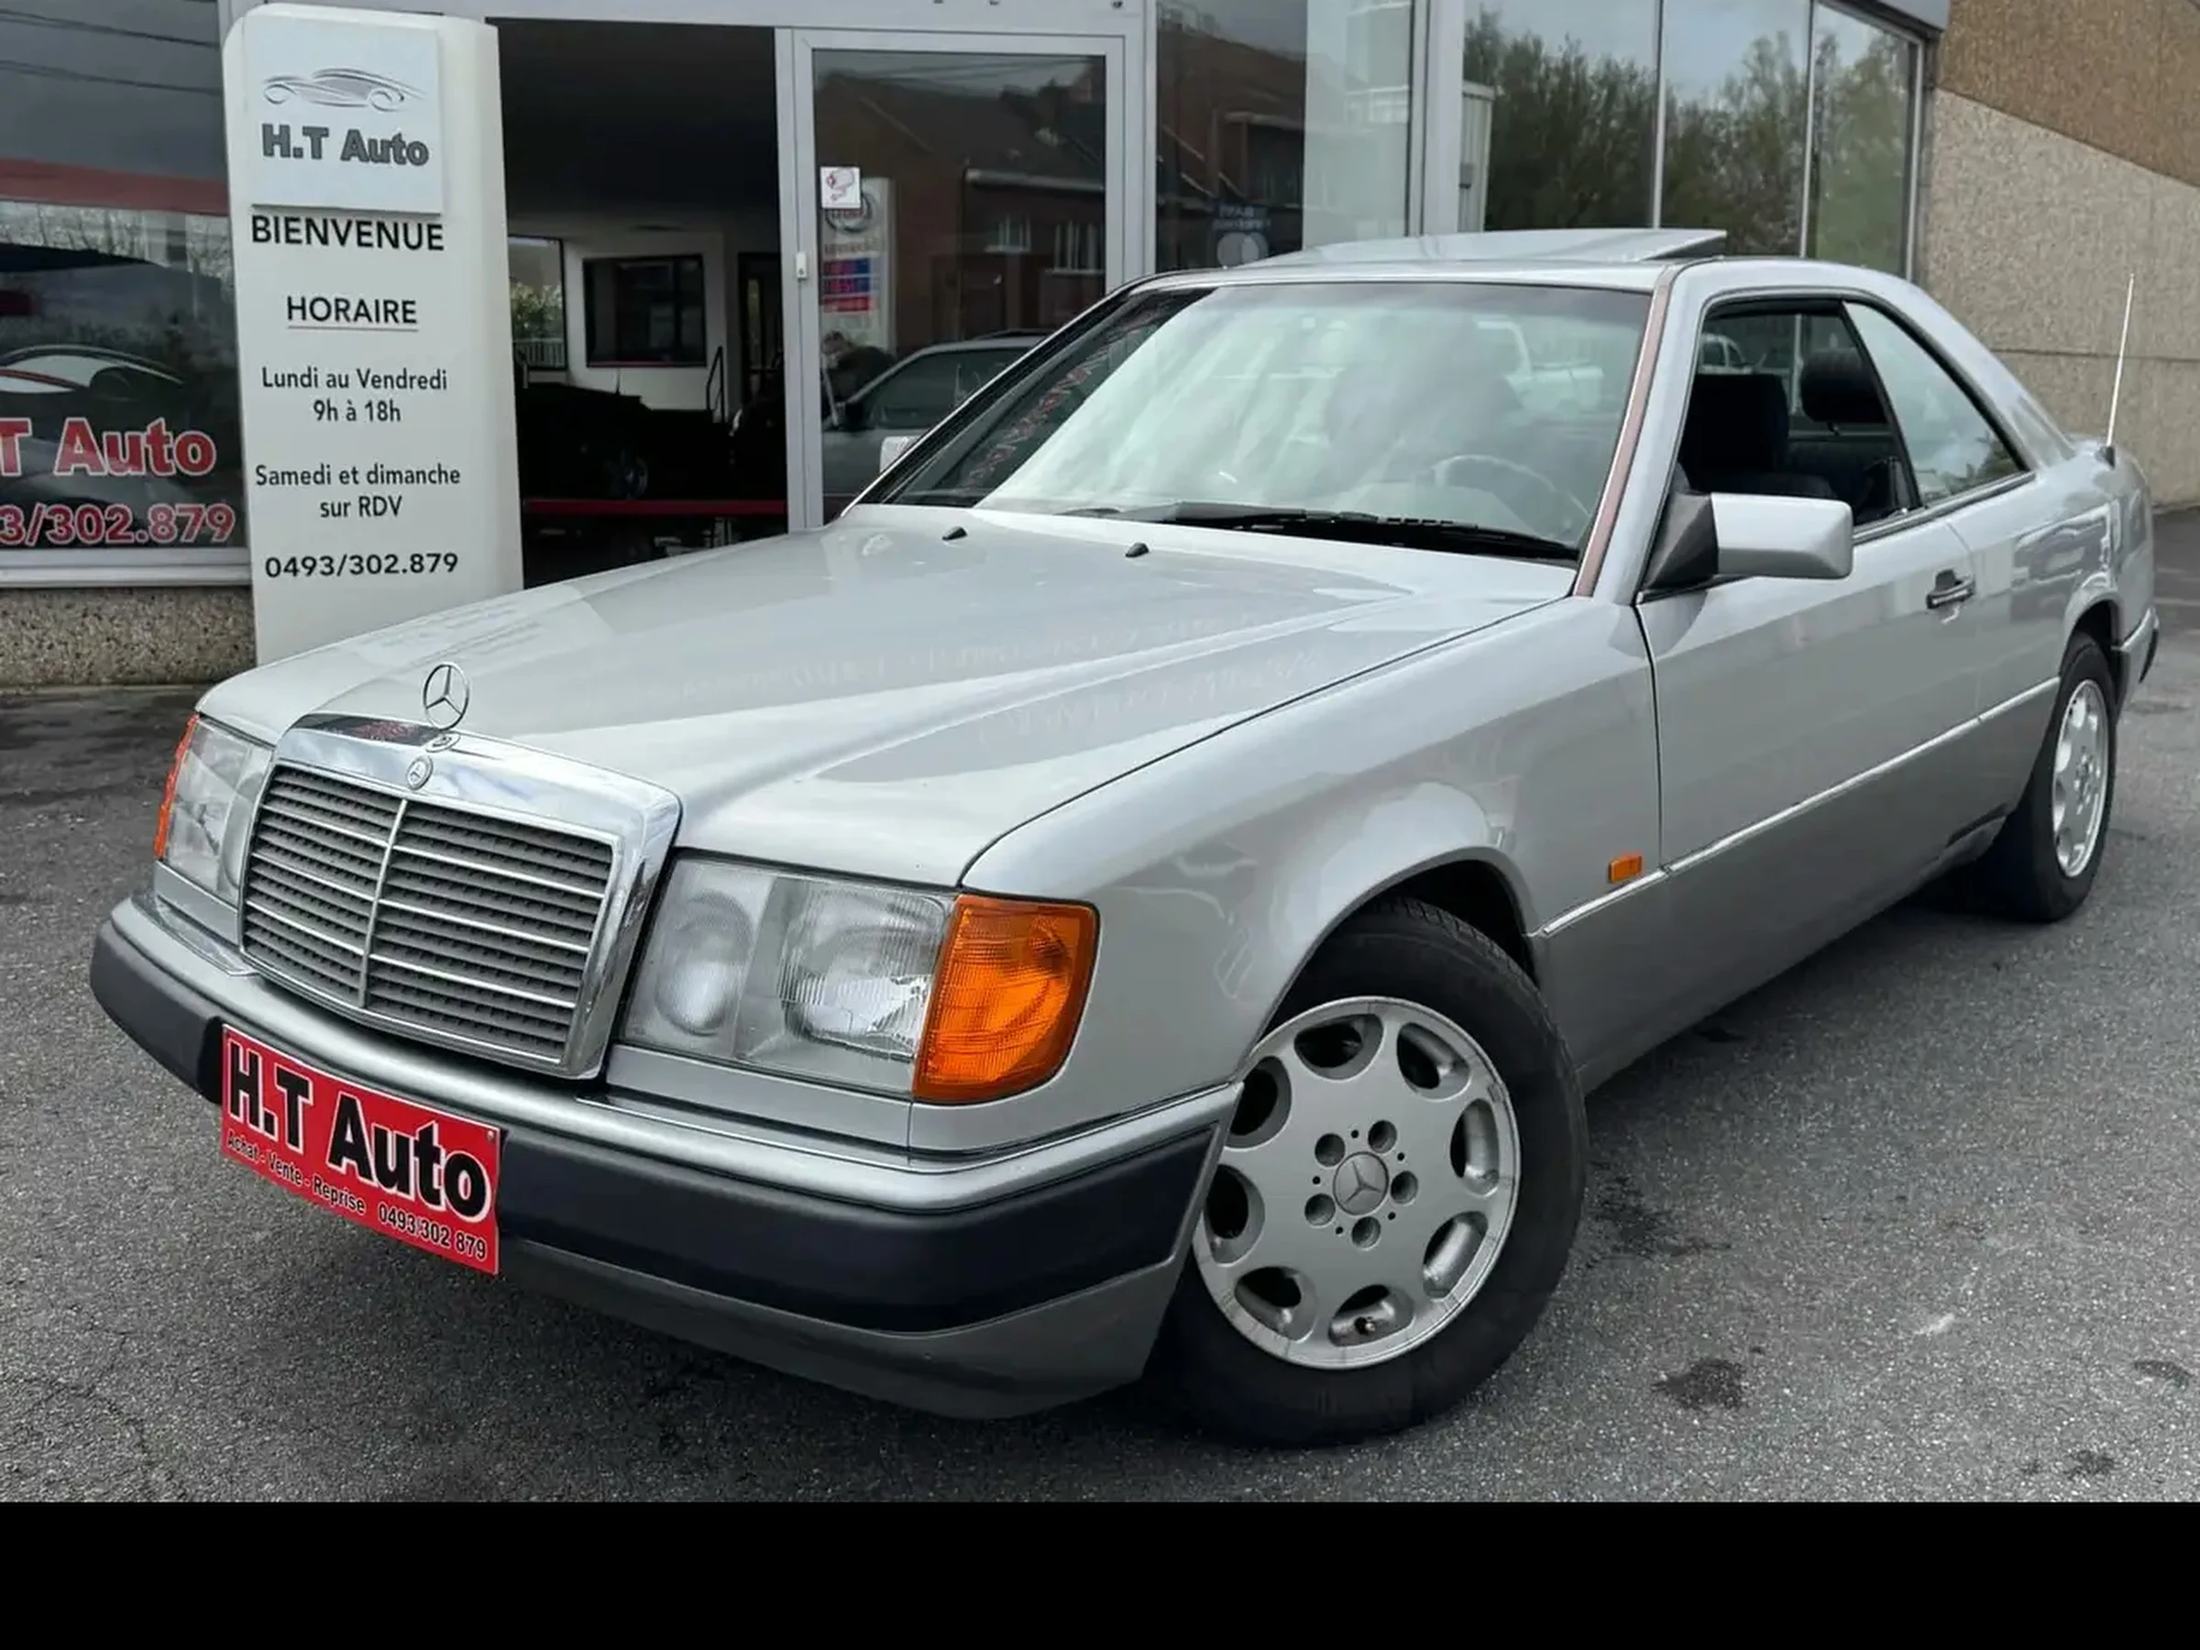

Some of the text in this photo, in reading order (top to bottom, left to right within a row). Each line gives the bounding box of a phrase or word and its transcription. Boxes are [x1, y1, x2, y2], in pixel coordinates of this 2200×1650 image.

[262, 123, 429, 166] H.T Auto
[251, 215, 444, 251] BIENVENUE
[287, 296, 418, 324] HORAIRE
[261, 366, 447, 390] Lundi au Vendredi
[313, 398, 401, 421] 9h à 18h
[53, 417, 216, 476] Auto
[255, 463, 461, 485] Samedi et dimanche
[320, 495, 402, 518] sur RDV
[265, 553, 458, 578] 0493/302.879
[228, 1038, 490, 1222] H.T Auto
[268, 1152, 302, 1186] Vente
[312, 1173, 366, 1216] Reprise
[455, 1230, 487, 1262] 879
